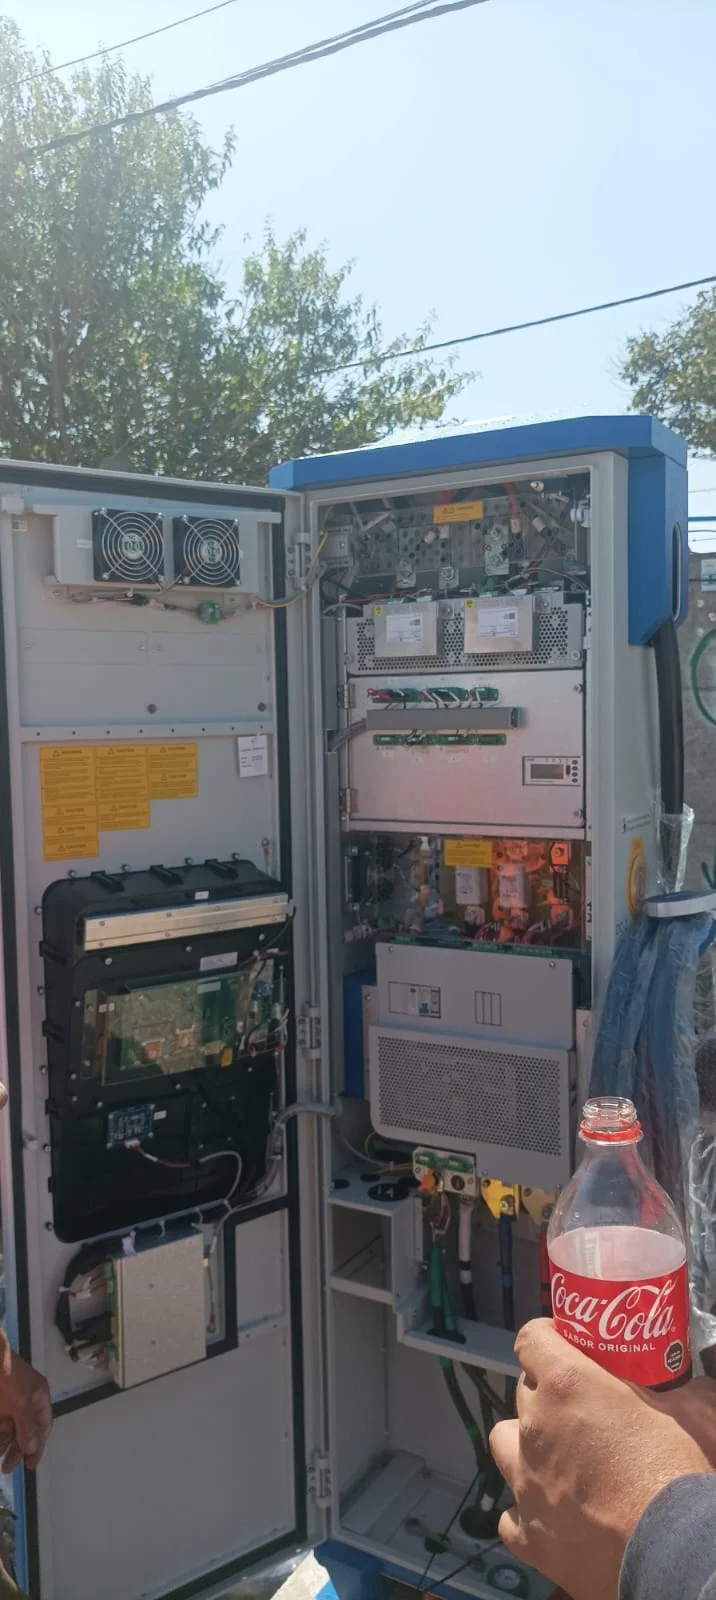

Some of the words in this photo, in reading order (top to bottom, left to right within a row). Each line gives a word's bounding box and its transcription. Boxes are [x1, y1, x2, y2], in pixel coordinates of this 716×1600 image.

[551, 1272, 678, 1341] Coca-Cola
[563, 1329, 594, 1349] SABOR
[598, 1342, 656, 1353] ORIGINAL
